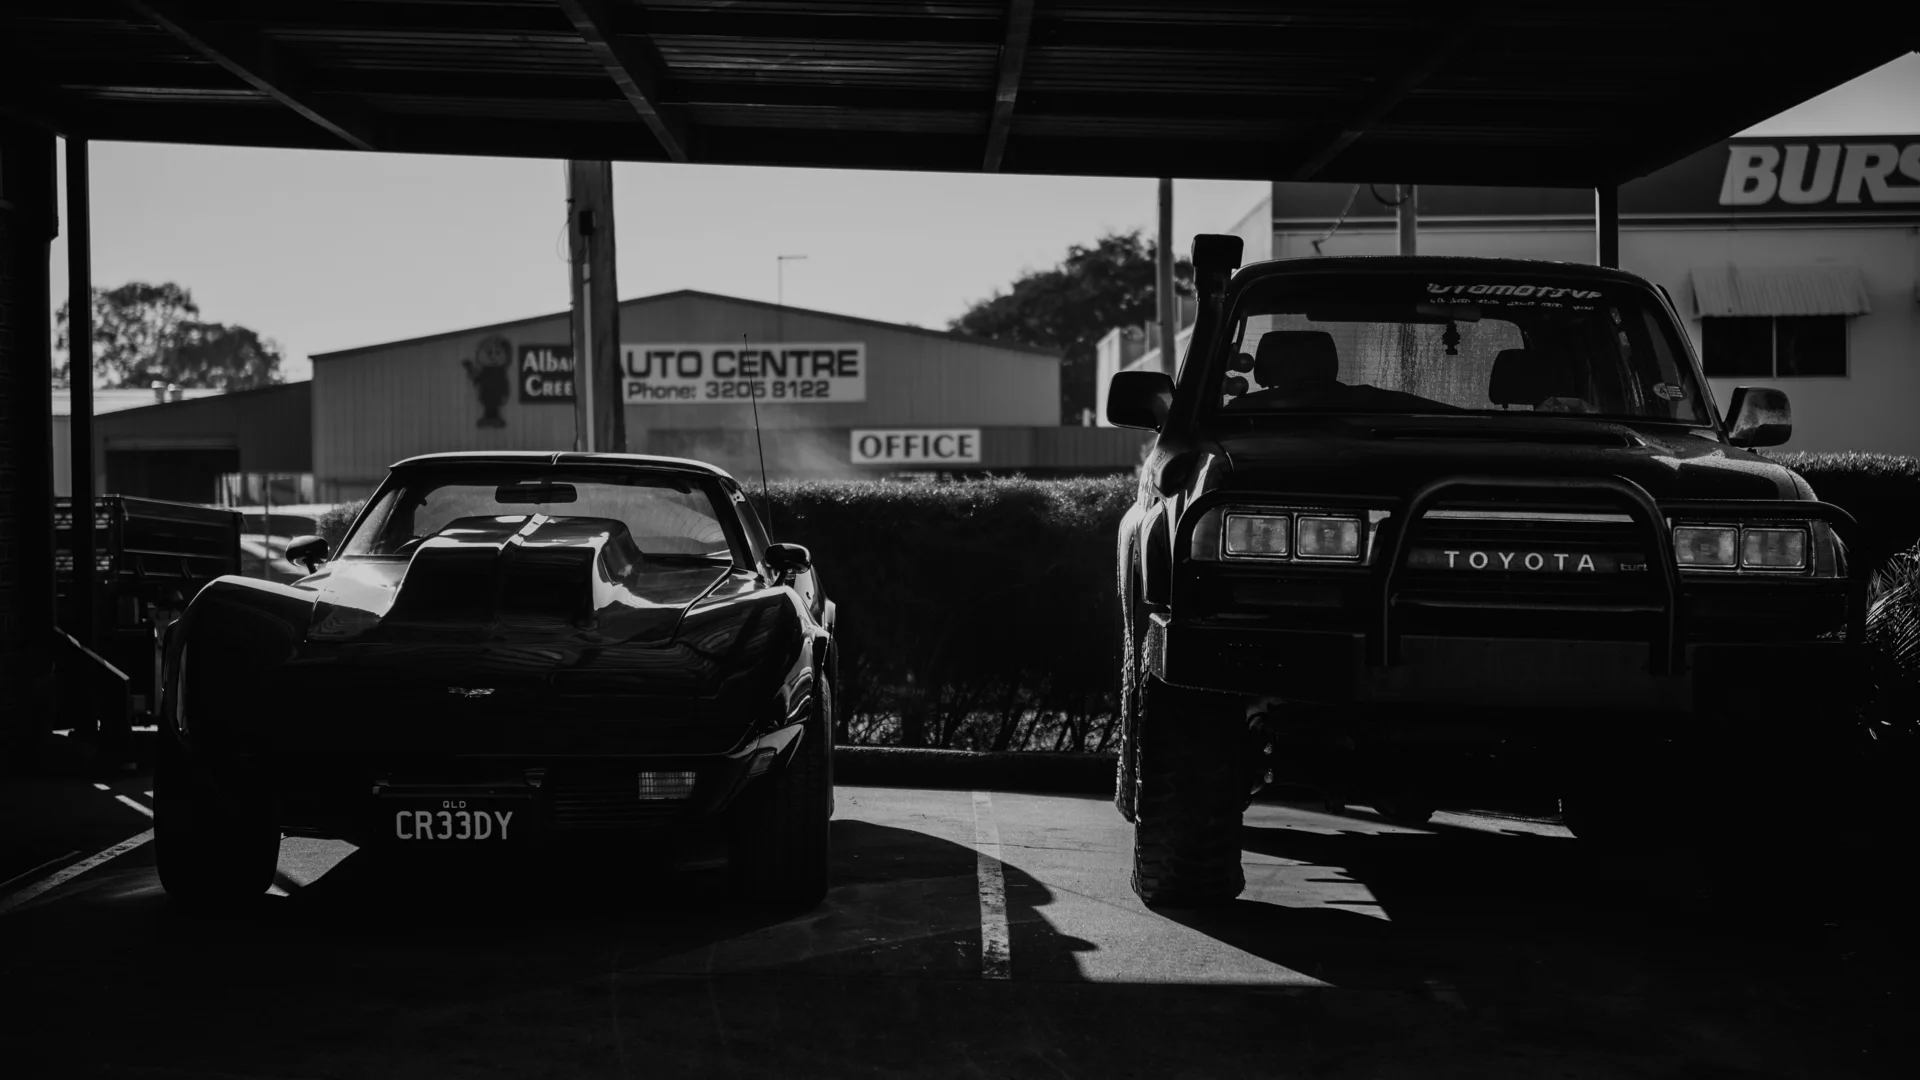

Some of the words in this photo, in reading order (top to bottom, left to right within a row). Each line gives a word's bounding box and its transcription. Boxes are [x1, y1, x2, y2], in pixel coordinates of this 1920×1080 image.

[620, 351, 702, 378] UTO
[713, 350, 858, 378] CENTRE
[628, 381, 697, 399] Phone:
[706, 381, 766, 398] 3205
[772, 381, 829, 398] 8122
[859, 435, 974, 458] OFFICE
[1444, 550, 1596, 572] TOYOTA
[442, 800, 467, 809] QLD
[395, 810, 514, 840] CR33DY
